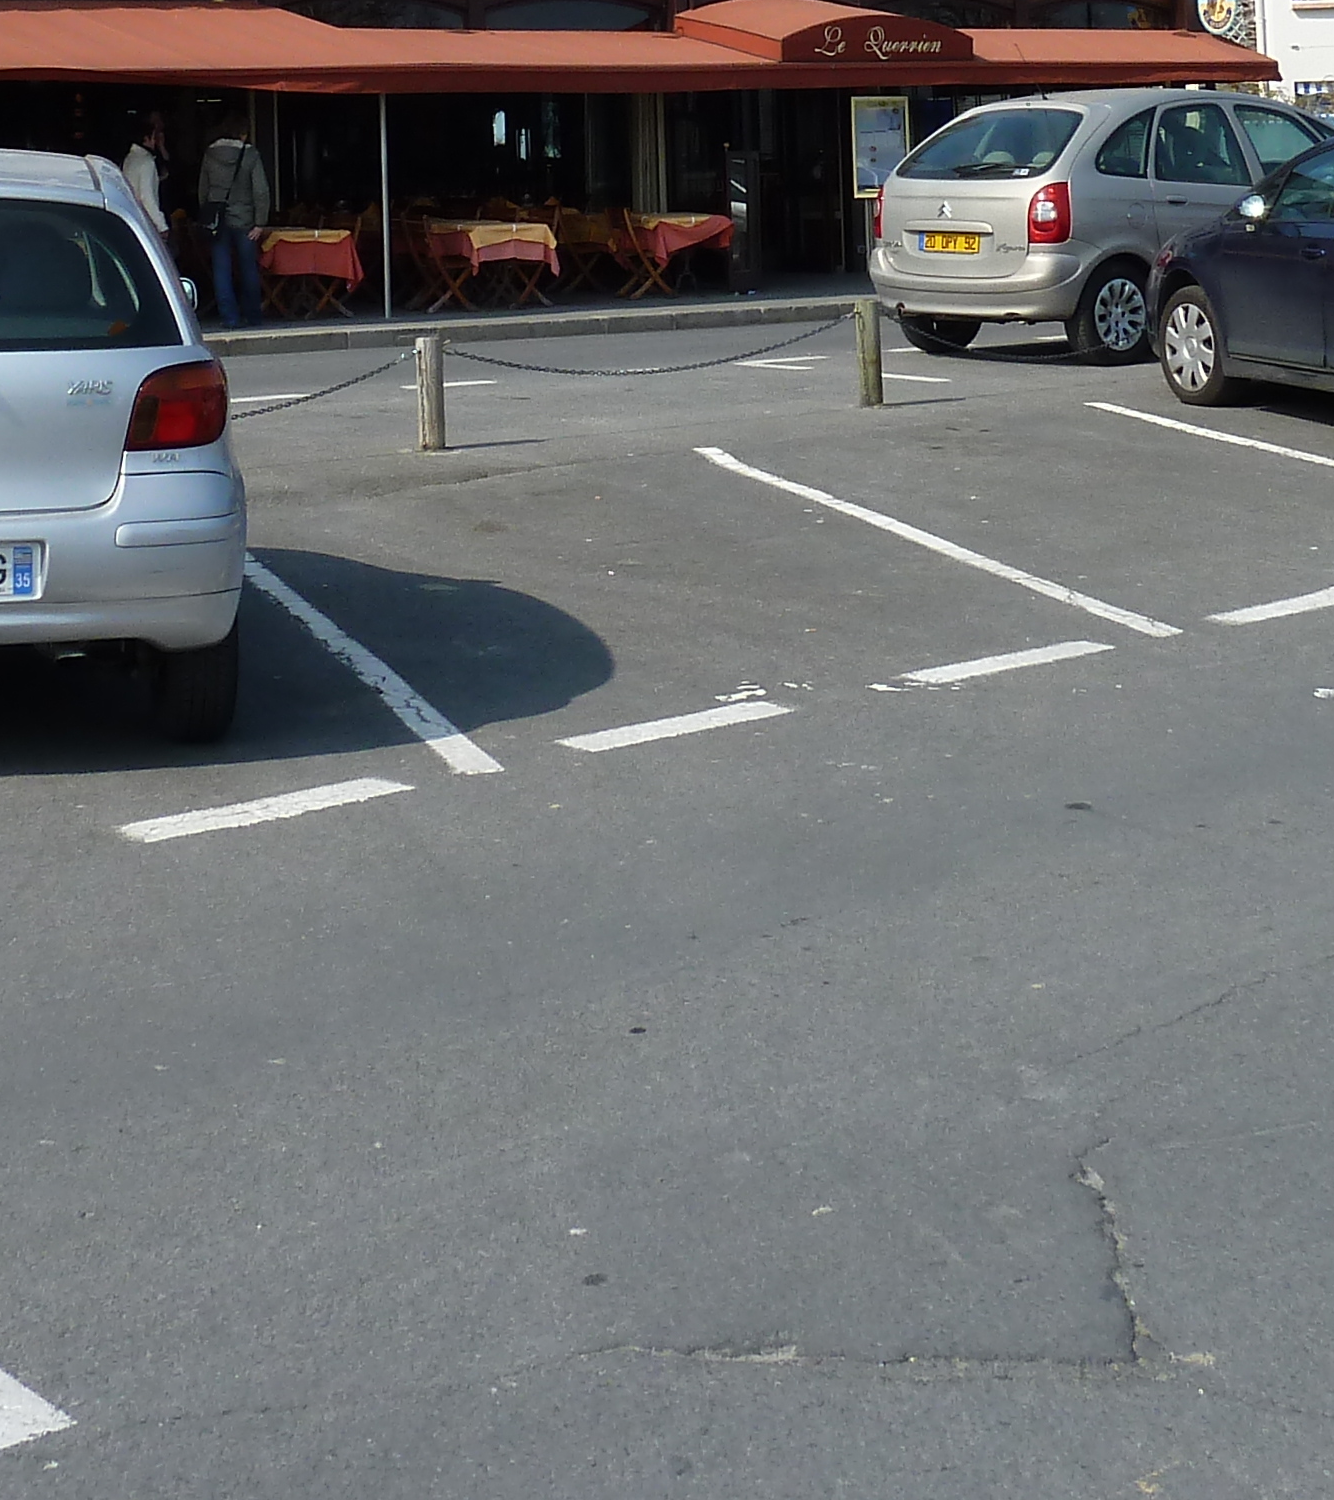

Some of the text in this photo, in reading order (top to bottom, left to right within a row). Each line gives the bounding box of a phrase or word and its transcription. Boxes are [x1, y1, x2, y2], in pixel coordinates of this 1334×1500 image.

[814, 25, 943, 60] Le Querrien
[67, 379, 114, 395] YARIS
[15, 573, 31, 588] 35
